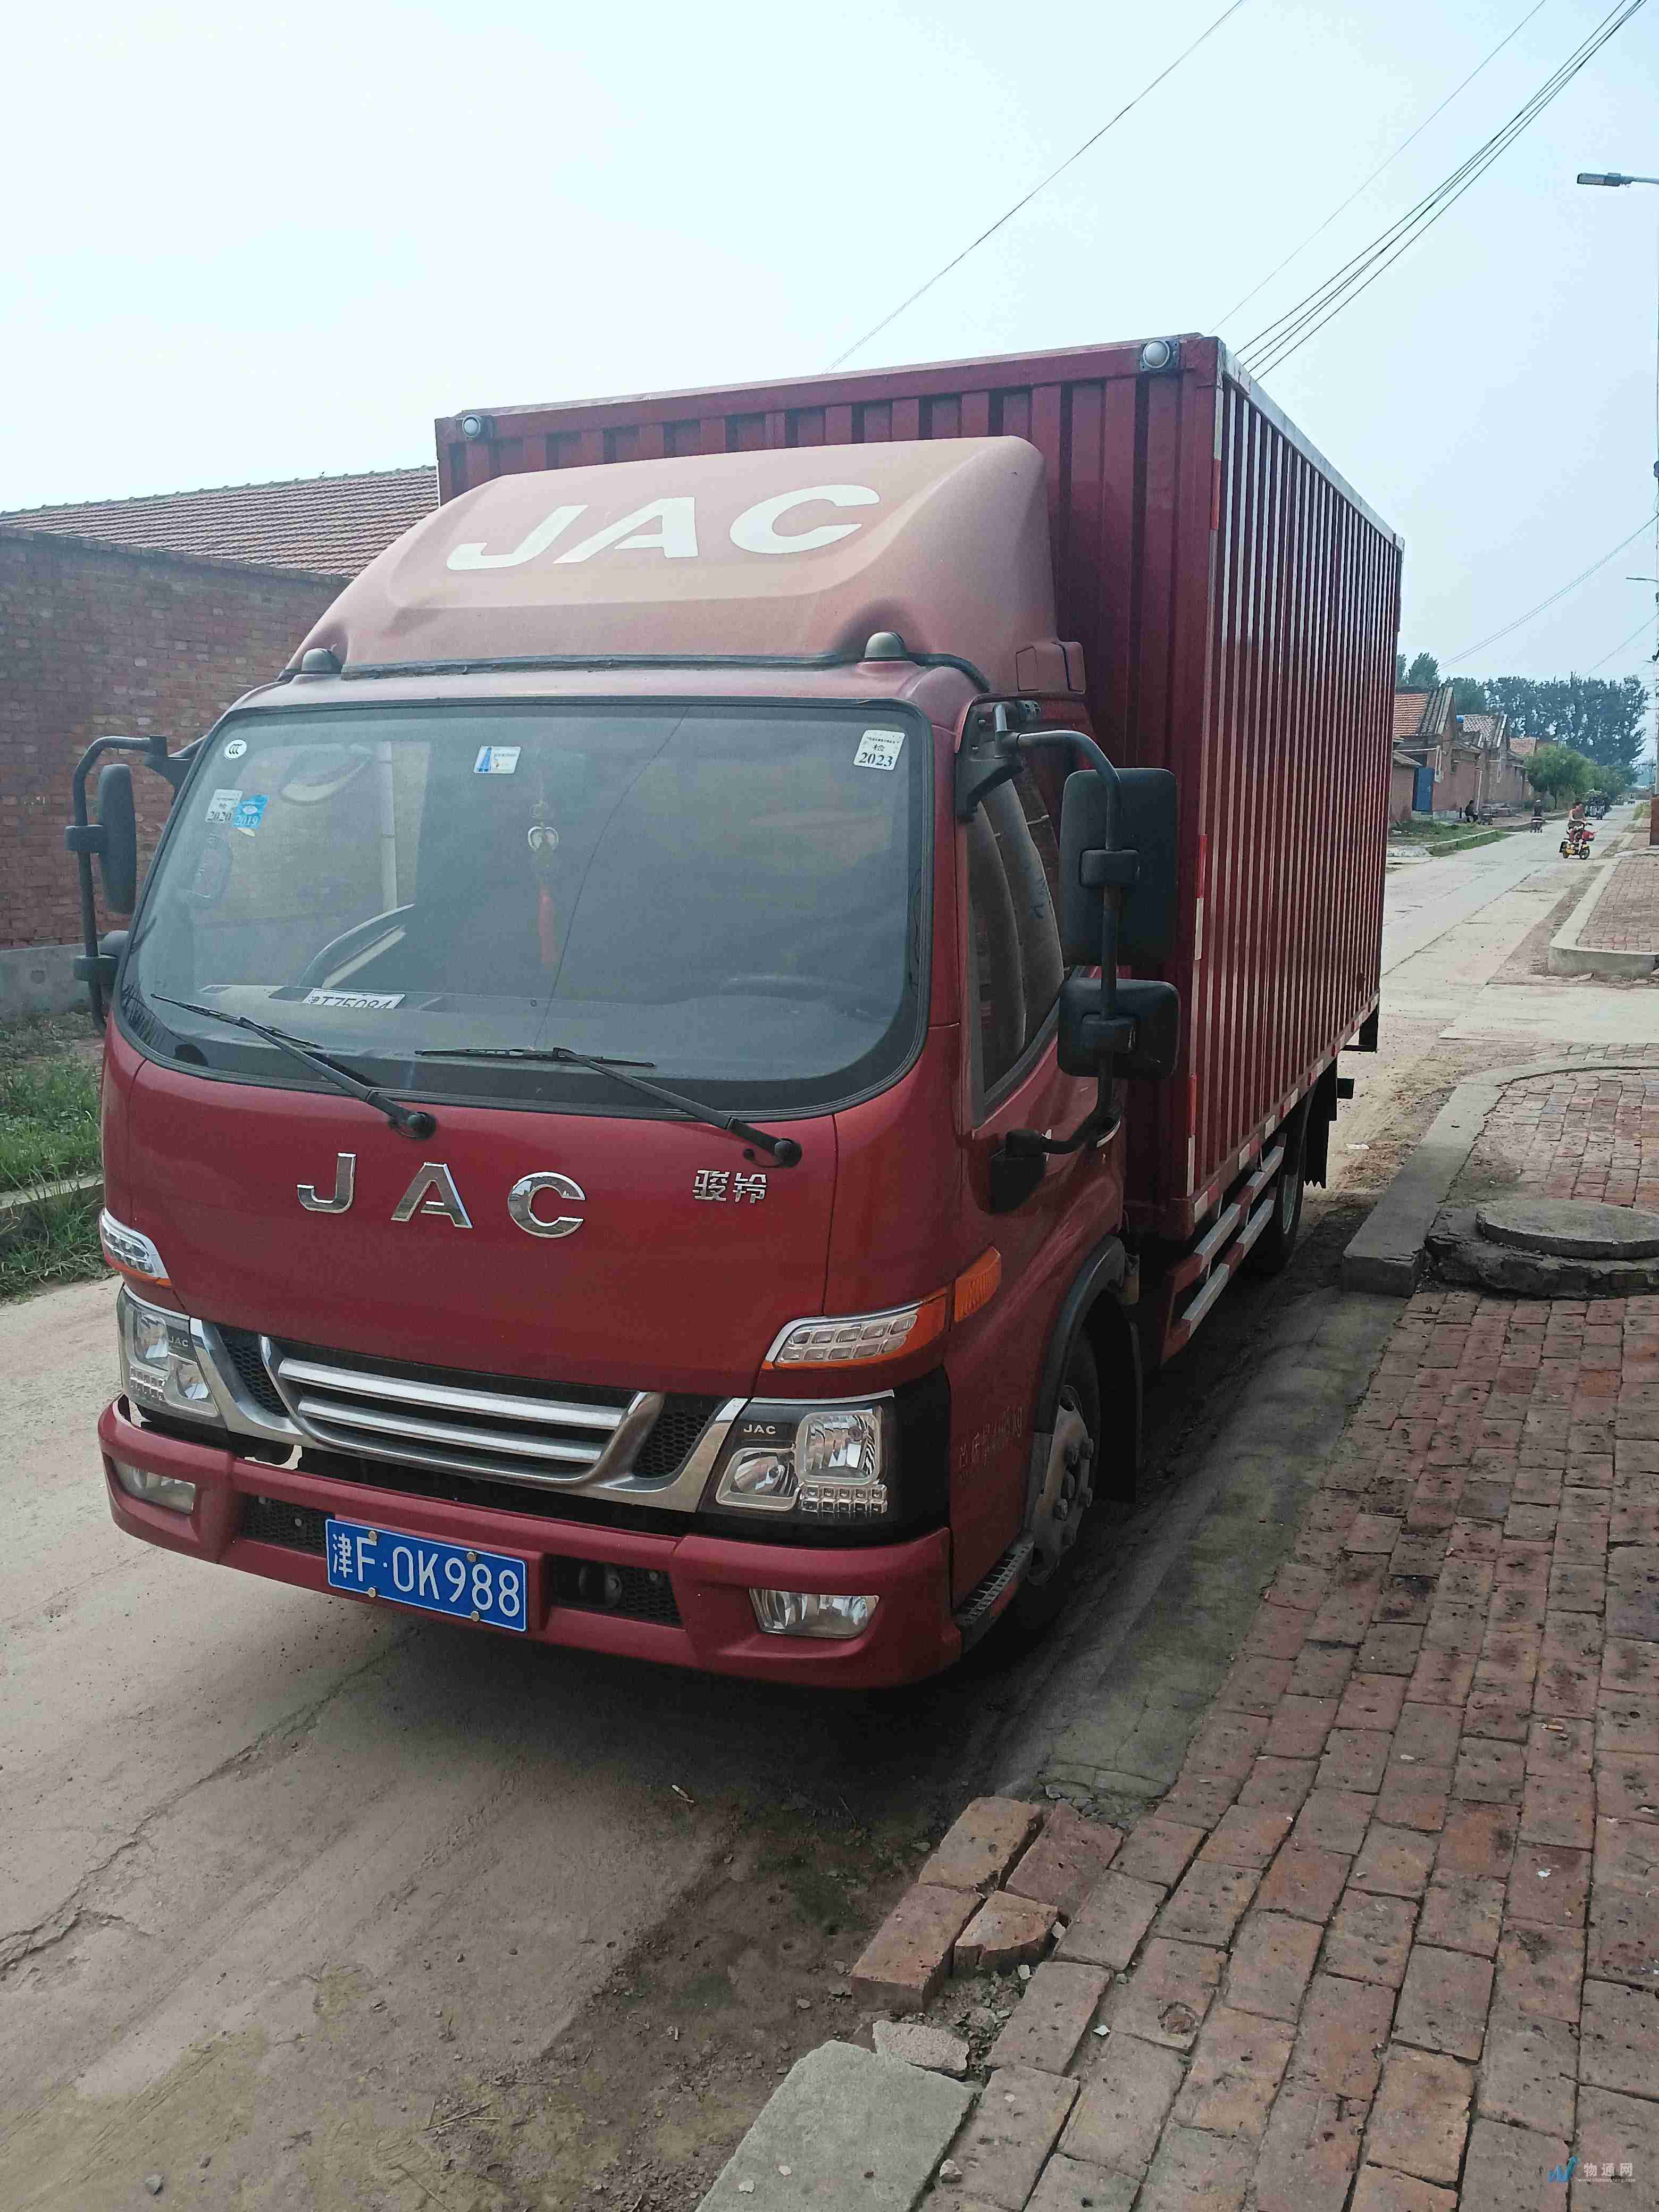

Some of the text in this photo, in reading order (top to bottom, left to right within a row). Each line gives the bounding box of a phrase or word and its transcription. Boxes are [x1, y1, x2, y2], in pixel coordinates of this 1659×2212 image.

[446, 484, 880, 570] JAC
[858, 752, 893, 767] 2023
[207, 811, 232, 822] 2020
[234, 815, 258, 826] 2019
[692, 1169, 767, 1203] 骏铃
[297, 1153, 586, 1238] JAC
[743, 1424, 776, 1435] JAC
